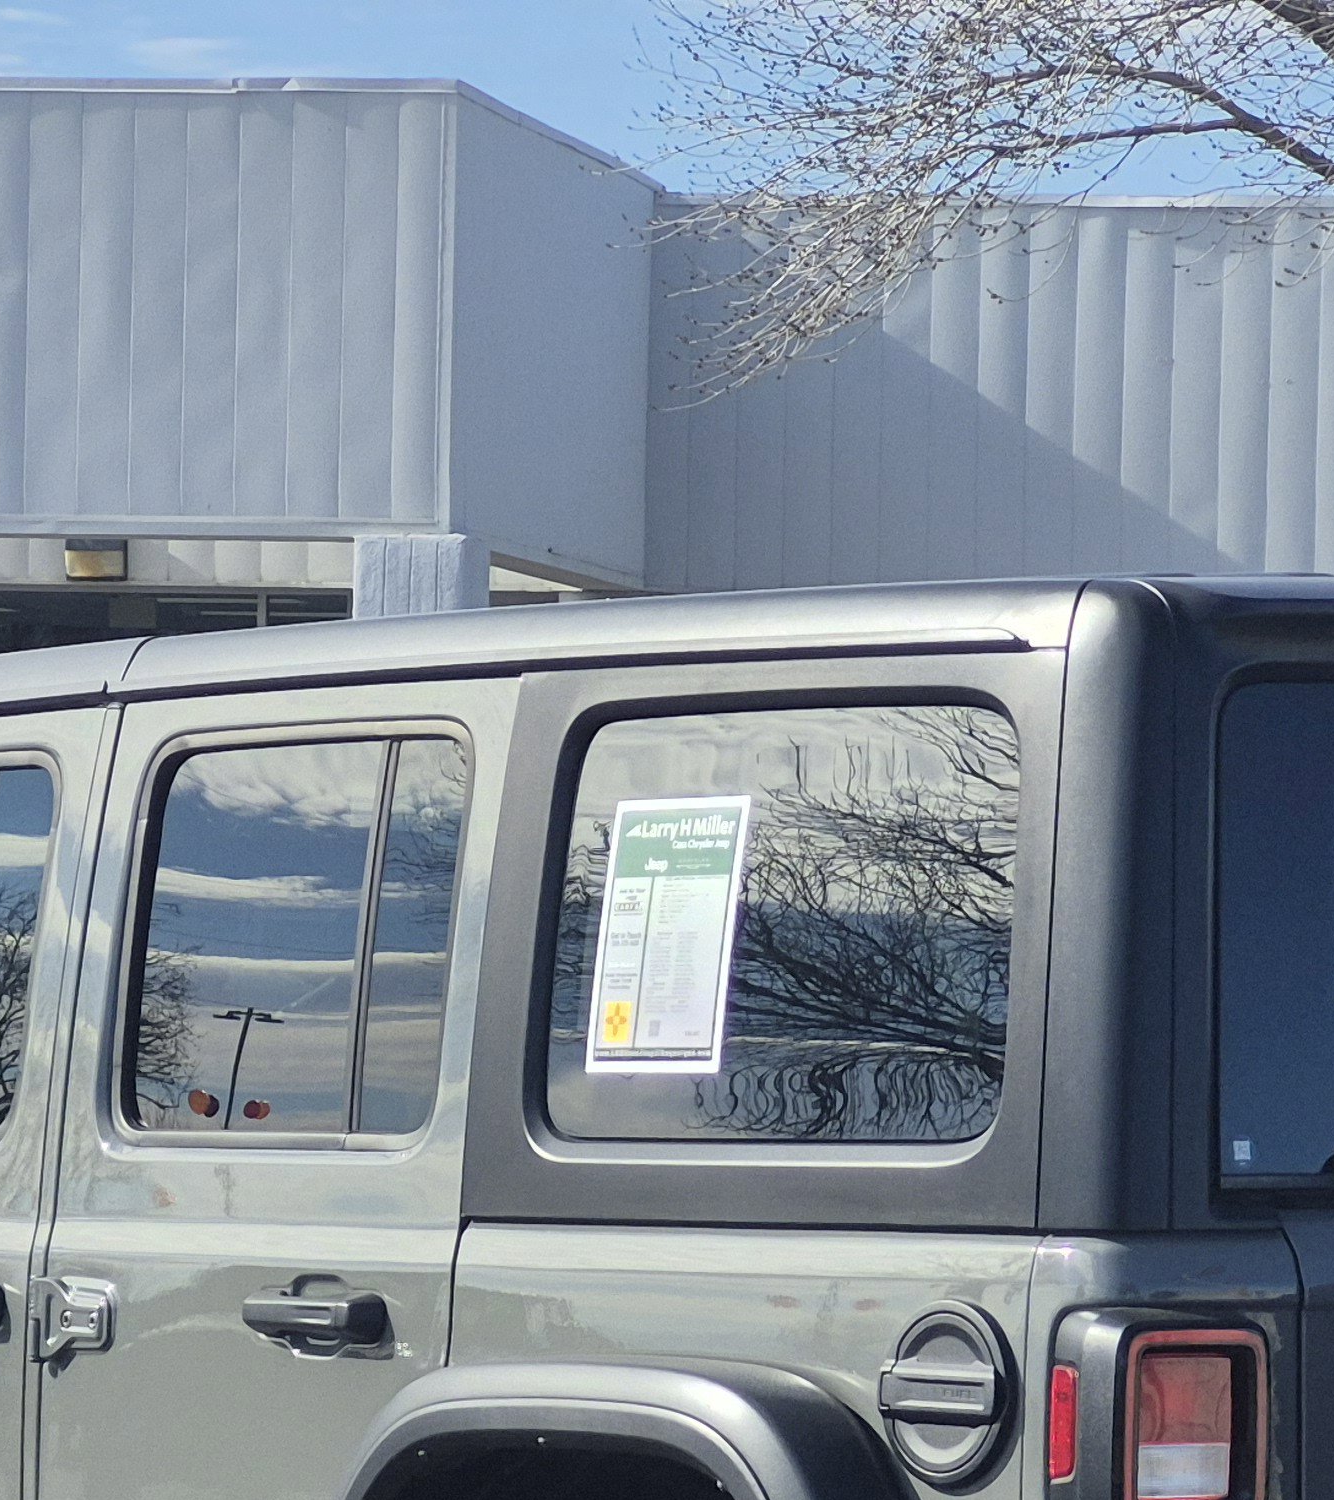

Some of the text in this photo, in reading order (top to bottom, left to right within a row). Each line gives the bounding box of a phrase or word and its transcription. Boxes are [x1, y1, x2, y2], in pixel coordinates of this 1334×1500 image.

[641, 814, 736, 842] Larry H Miller
